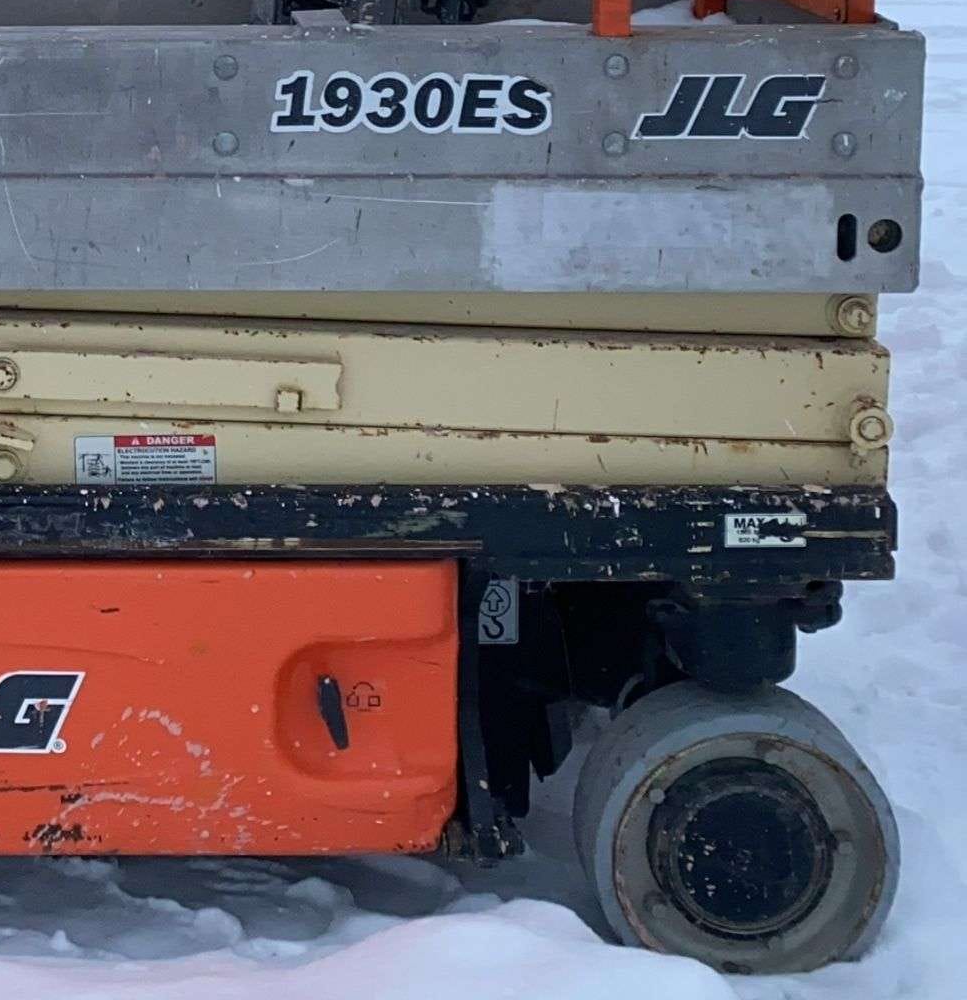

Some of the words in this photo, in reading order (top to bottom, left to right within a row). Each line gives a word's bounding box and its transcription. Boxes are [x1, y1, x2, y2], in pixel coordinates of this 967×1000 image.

[270, 69, 554, 136] 1930ES
[630, 74, 827, 140] JLG
[146, 436, 195, 446] DANGER
